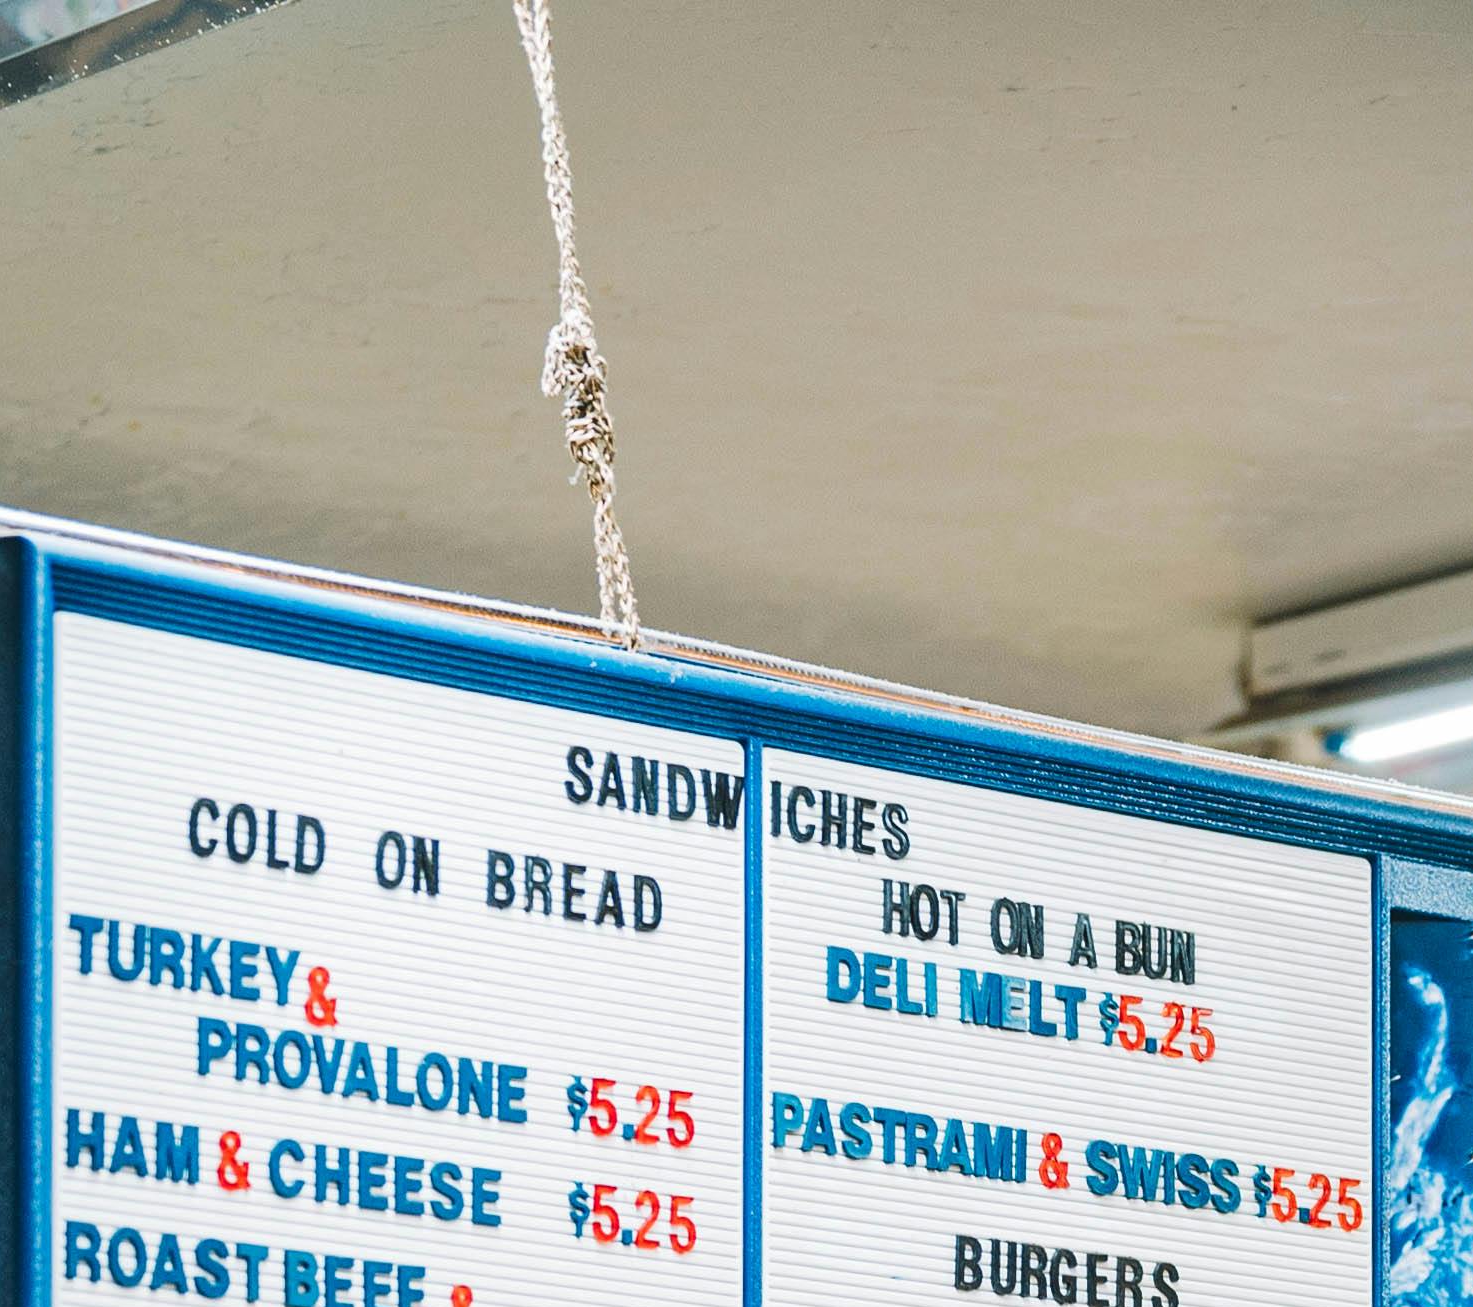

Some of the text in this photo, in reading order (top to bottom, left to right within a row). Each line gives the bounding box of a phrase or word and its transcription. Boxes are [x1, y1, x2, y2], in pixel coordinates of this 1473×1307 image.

[187, 797, 663, 933] COLD ON BREAD
[882, 878, 1197, 986] HOT ON A BUN
[826, 946, 1217, 1063] DELI MELT $5.25
[196, 1017, 695, 1148] PROVALONE $5.25
[65, 1109, 697, 1254] HAM & CHEESE $5.25
[771, 1091, 1363, 1233] PASTRAMI & SWISS $5.25
[63, 1219, 269, 1304] ROAST
